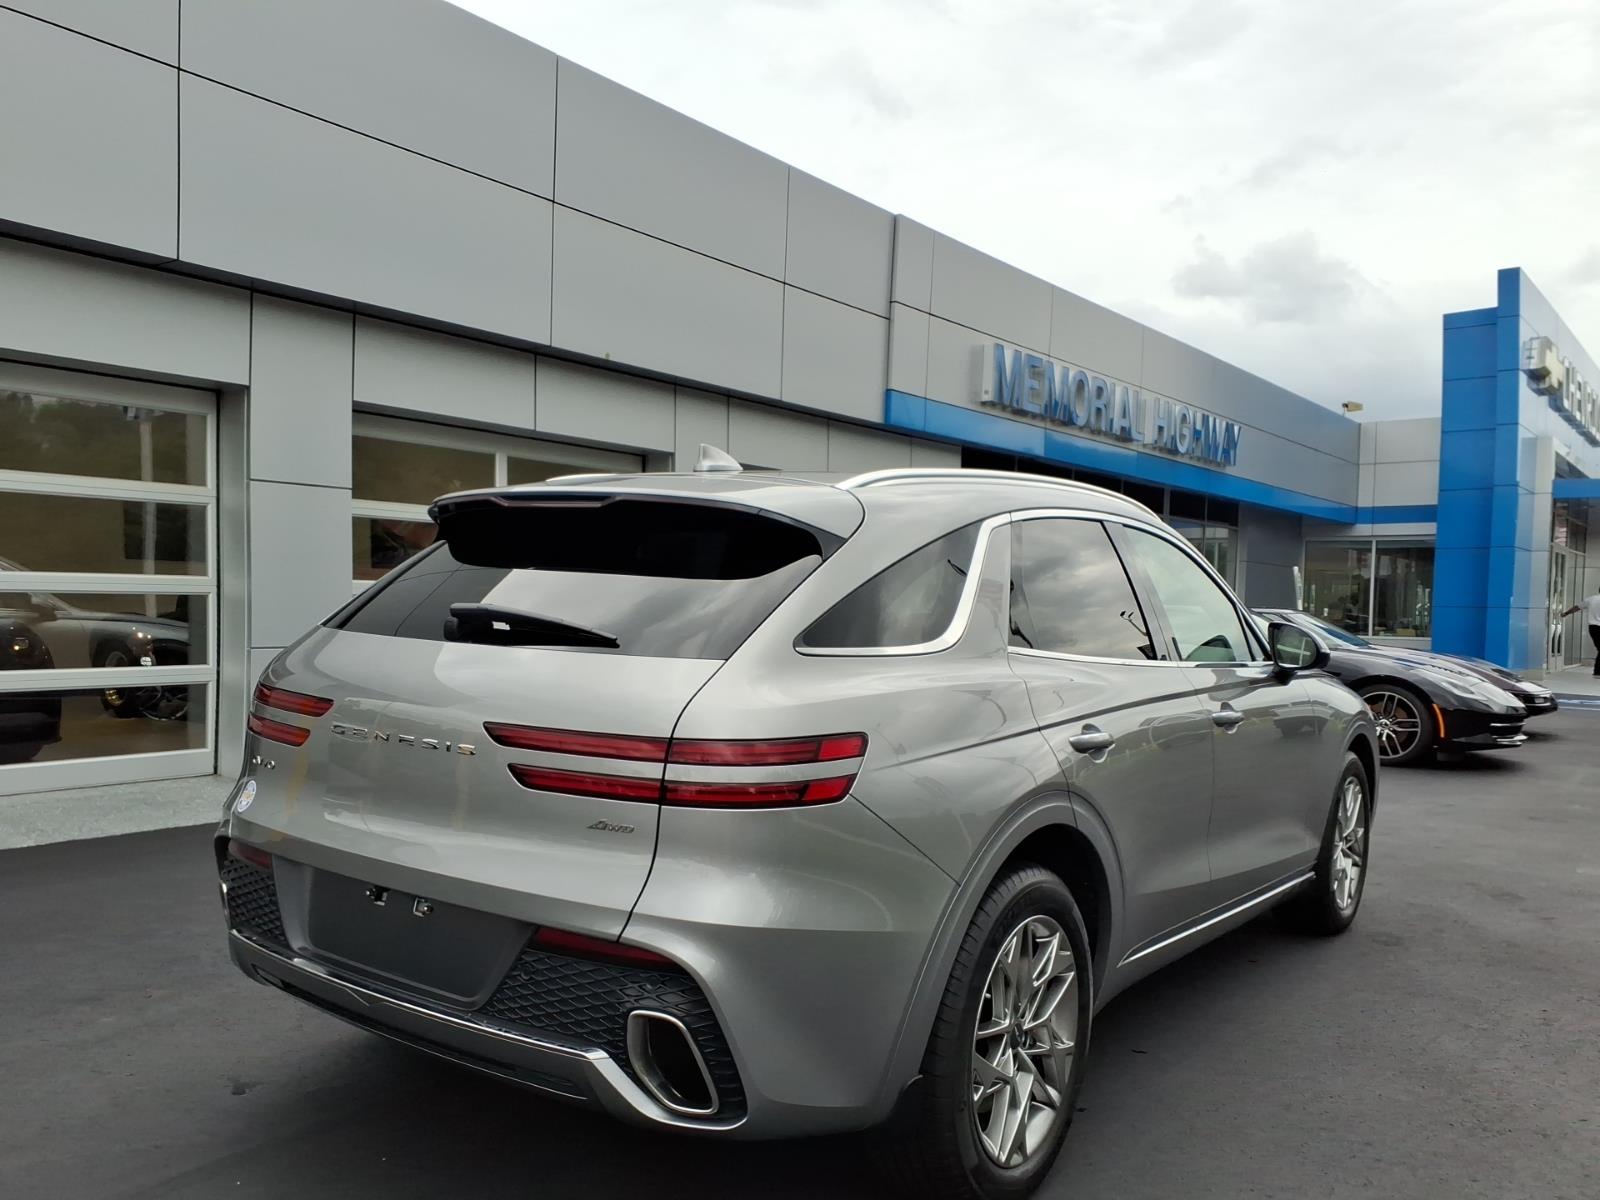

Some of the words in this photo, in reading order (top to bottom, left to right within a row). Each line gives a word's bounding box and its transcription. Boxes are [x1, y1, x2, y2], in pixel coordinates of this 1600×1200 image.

[984, 342, 1146, 443] MEMORIAL
[1148, 396, 1242, 467] HIGHWAY
[331, 723, 476, 756] GENESIS
